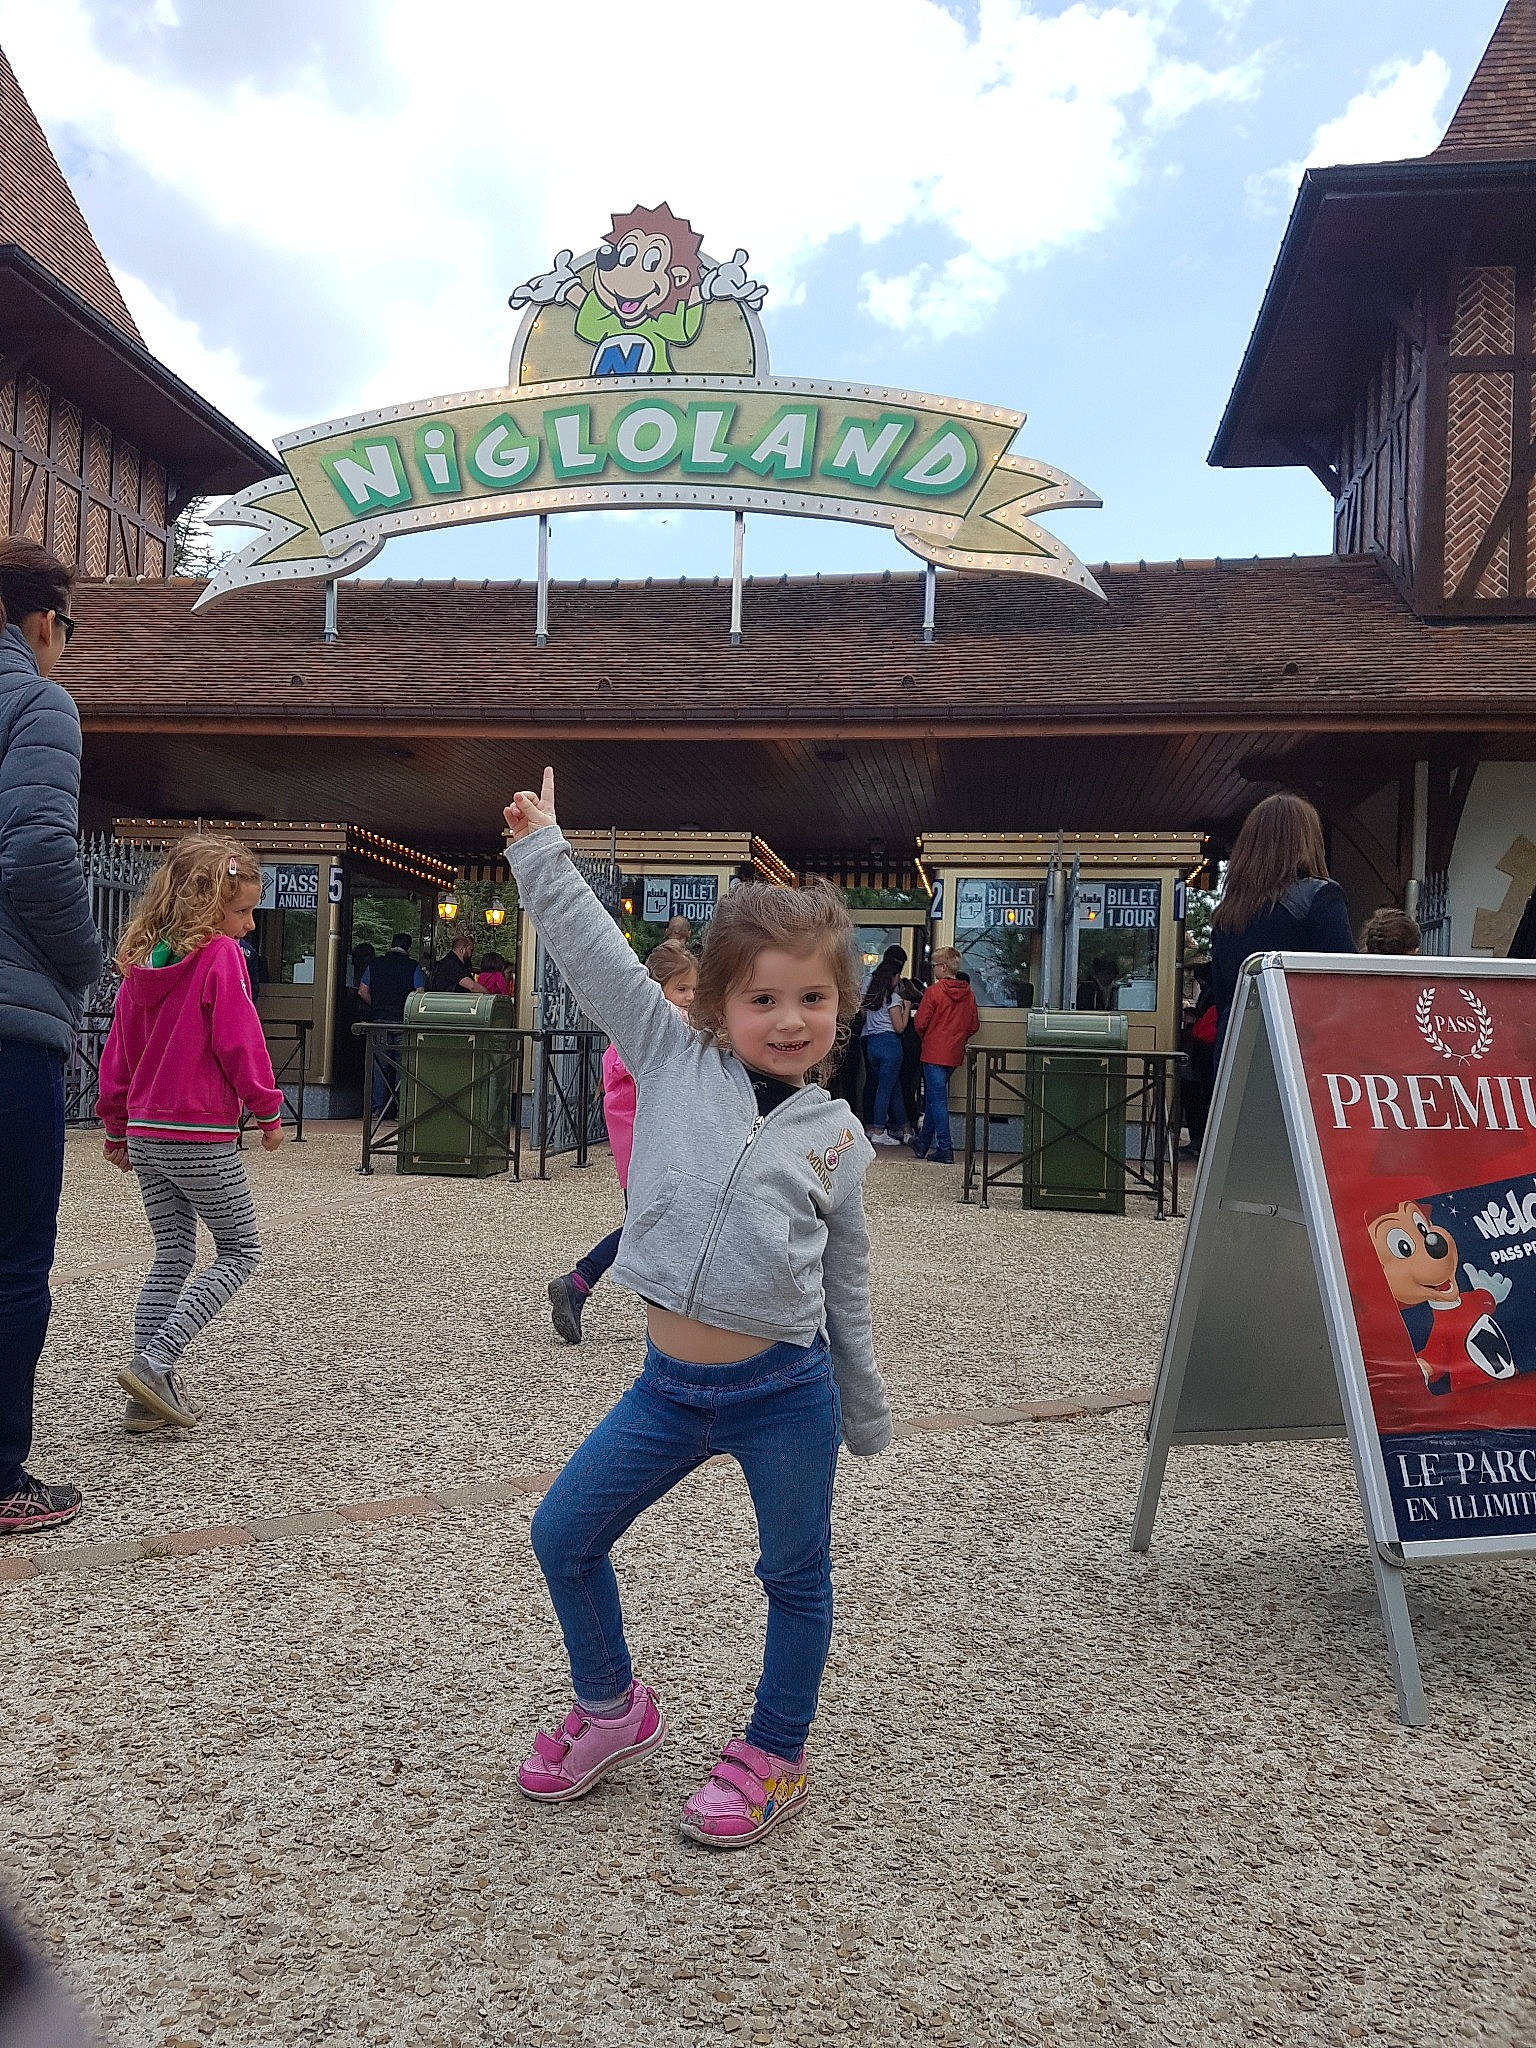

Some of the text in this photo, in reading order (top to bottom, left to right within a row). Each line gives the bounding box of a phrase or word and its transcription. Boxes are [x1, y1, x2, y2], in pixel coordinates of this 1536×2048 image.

[278, 873, 318, 893] PASS
[329, 867, 343, 902] 5
[672, 883, 716, 900] BILLET
[278, 894, 318, 909] ANNUEL
[931, 881, 943, 918] 2
[988, 888, 1036, 905] BILLET
[1107, 888, 1159, 906] BILLET
[1175, 881, 1185, 919] 1
[1434, 1015, 1477, 1033] PASS
[806, 1149, 833, 1195] MINNIE
[1490, 1244, 1524, 1265] PASS
[1396, 1449, 1536, 1488] LE PARC
[1405, 1496, 1439, 1522] EN
